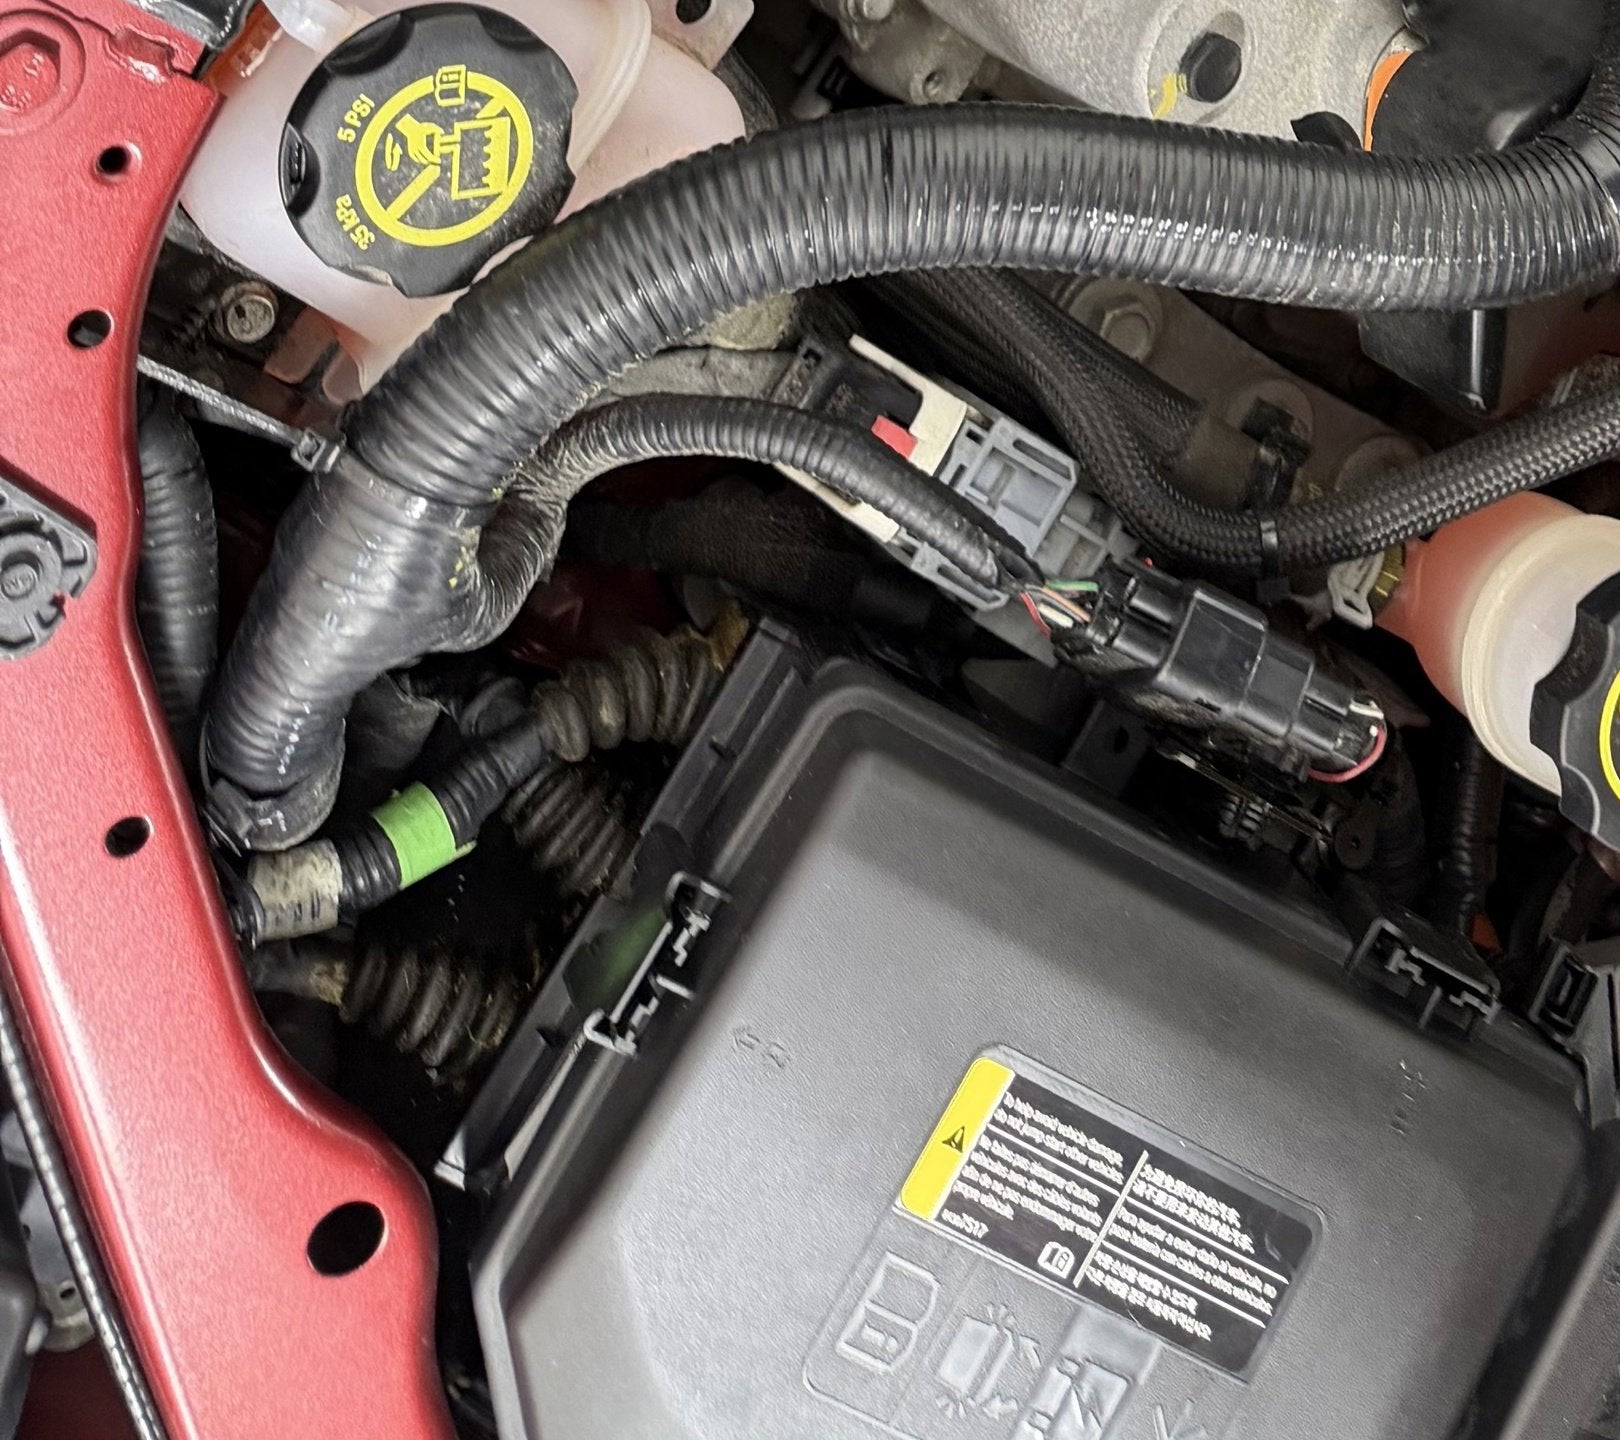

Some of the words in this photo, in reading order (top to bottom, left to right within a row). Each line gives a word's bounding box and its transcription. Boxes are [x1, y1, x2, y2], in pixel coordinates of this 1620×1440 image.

[344, 93, 376, 128] PSI
[336, 126, 356, 144] 5
[335, 193, 361, 232] kPa
[349, 223, 376, 251] 35
